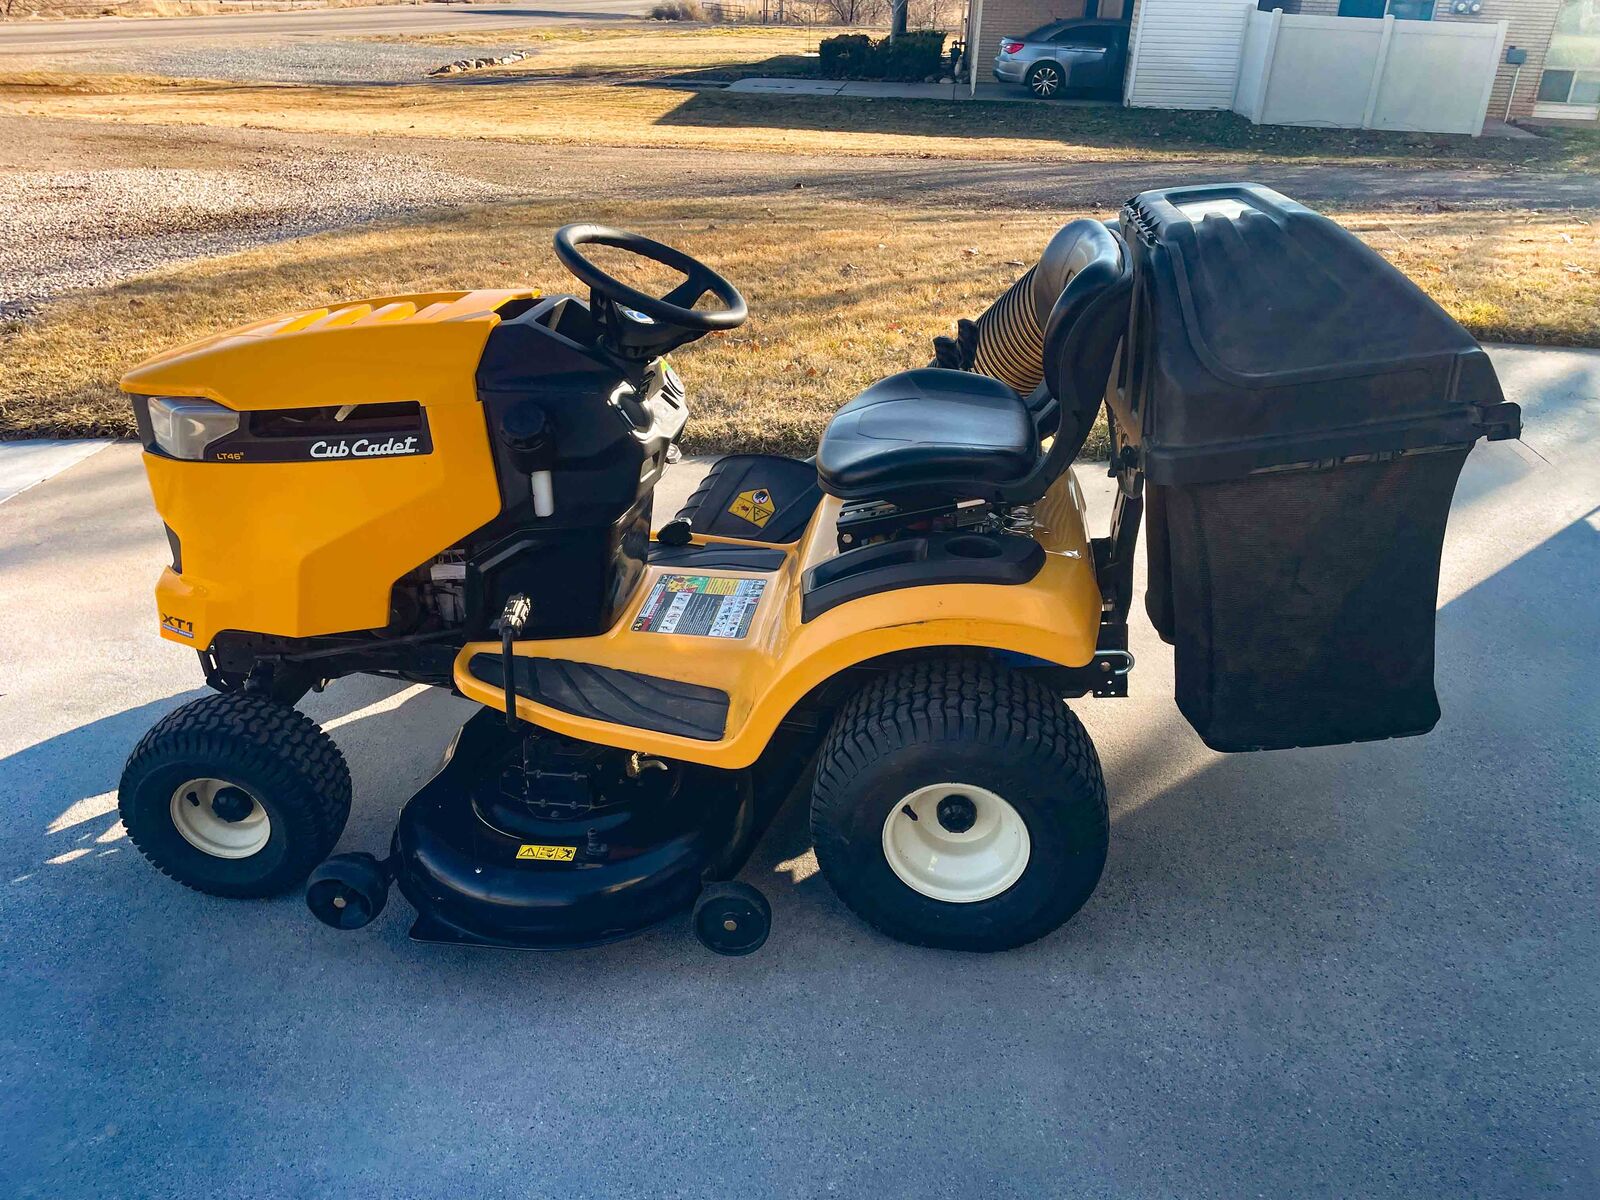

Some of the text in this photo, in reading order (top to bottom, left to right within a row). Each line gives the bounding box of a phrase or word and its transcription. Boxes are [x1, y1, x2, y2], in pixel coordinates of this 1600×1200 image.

[310, 436, 418, 458] Cub Cadet
[162, 612, 193, 632] XT1
